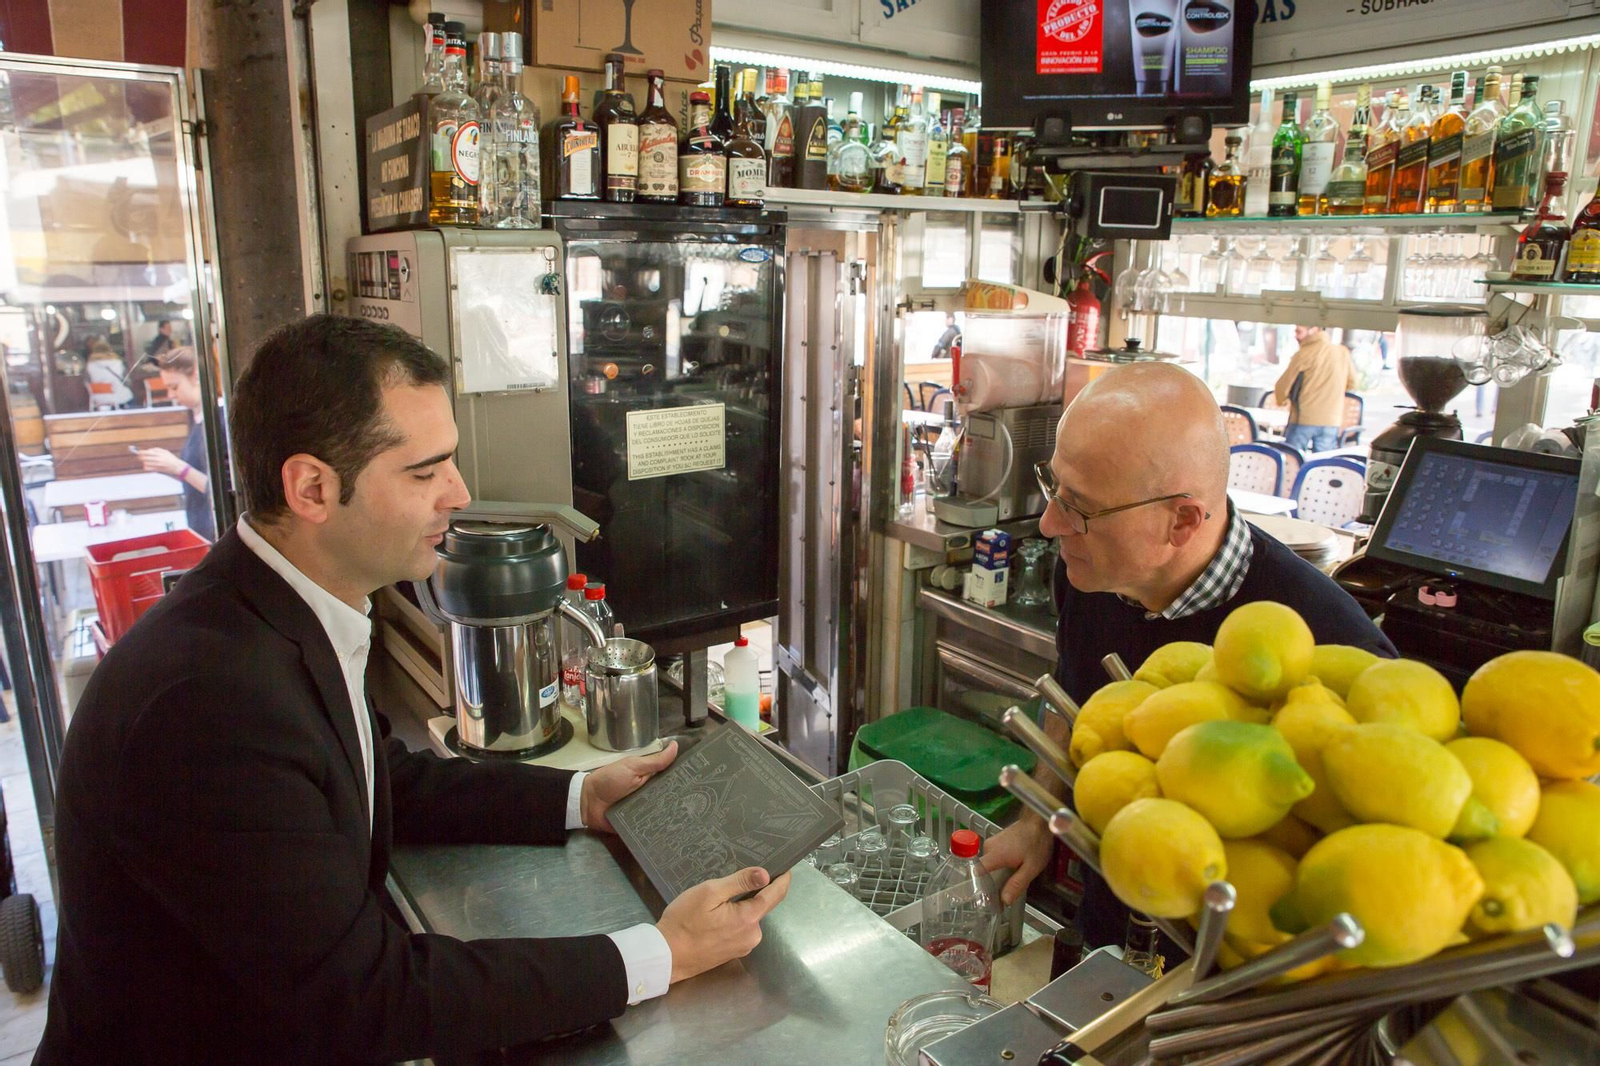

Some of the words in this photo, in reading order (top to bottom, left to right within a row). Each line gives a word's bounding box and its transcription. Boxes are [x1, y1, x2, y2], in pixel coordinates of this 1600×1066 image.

[1043, 4, 1097, 34] PRODUCTO
[1060, 31, 1075, 39] DEL
[1185, 46, 1229, 54] SHAMPOO
[616, 143, 638, 151] ABUEL
[458, 150, 478, 158] NEGR
[661, 410, 707, 419] ESTABLECIMIENTO
[638, 427, 682, 437] RECLAMACIONES
[643, 434, 678, 444] CONSUMIDOR
[699, 430, 721, 438] SOLICITE
[645, 448, 686, 459] ESTABLISHMENT
[650, 456, 679, 466] COMPLAINT
[633, 466, 666, 475] DISPOSITION
[693, 459, 716, 467] REQUEST
